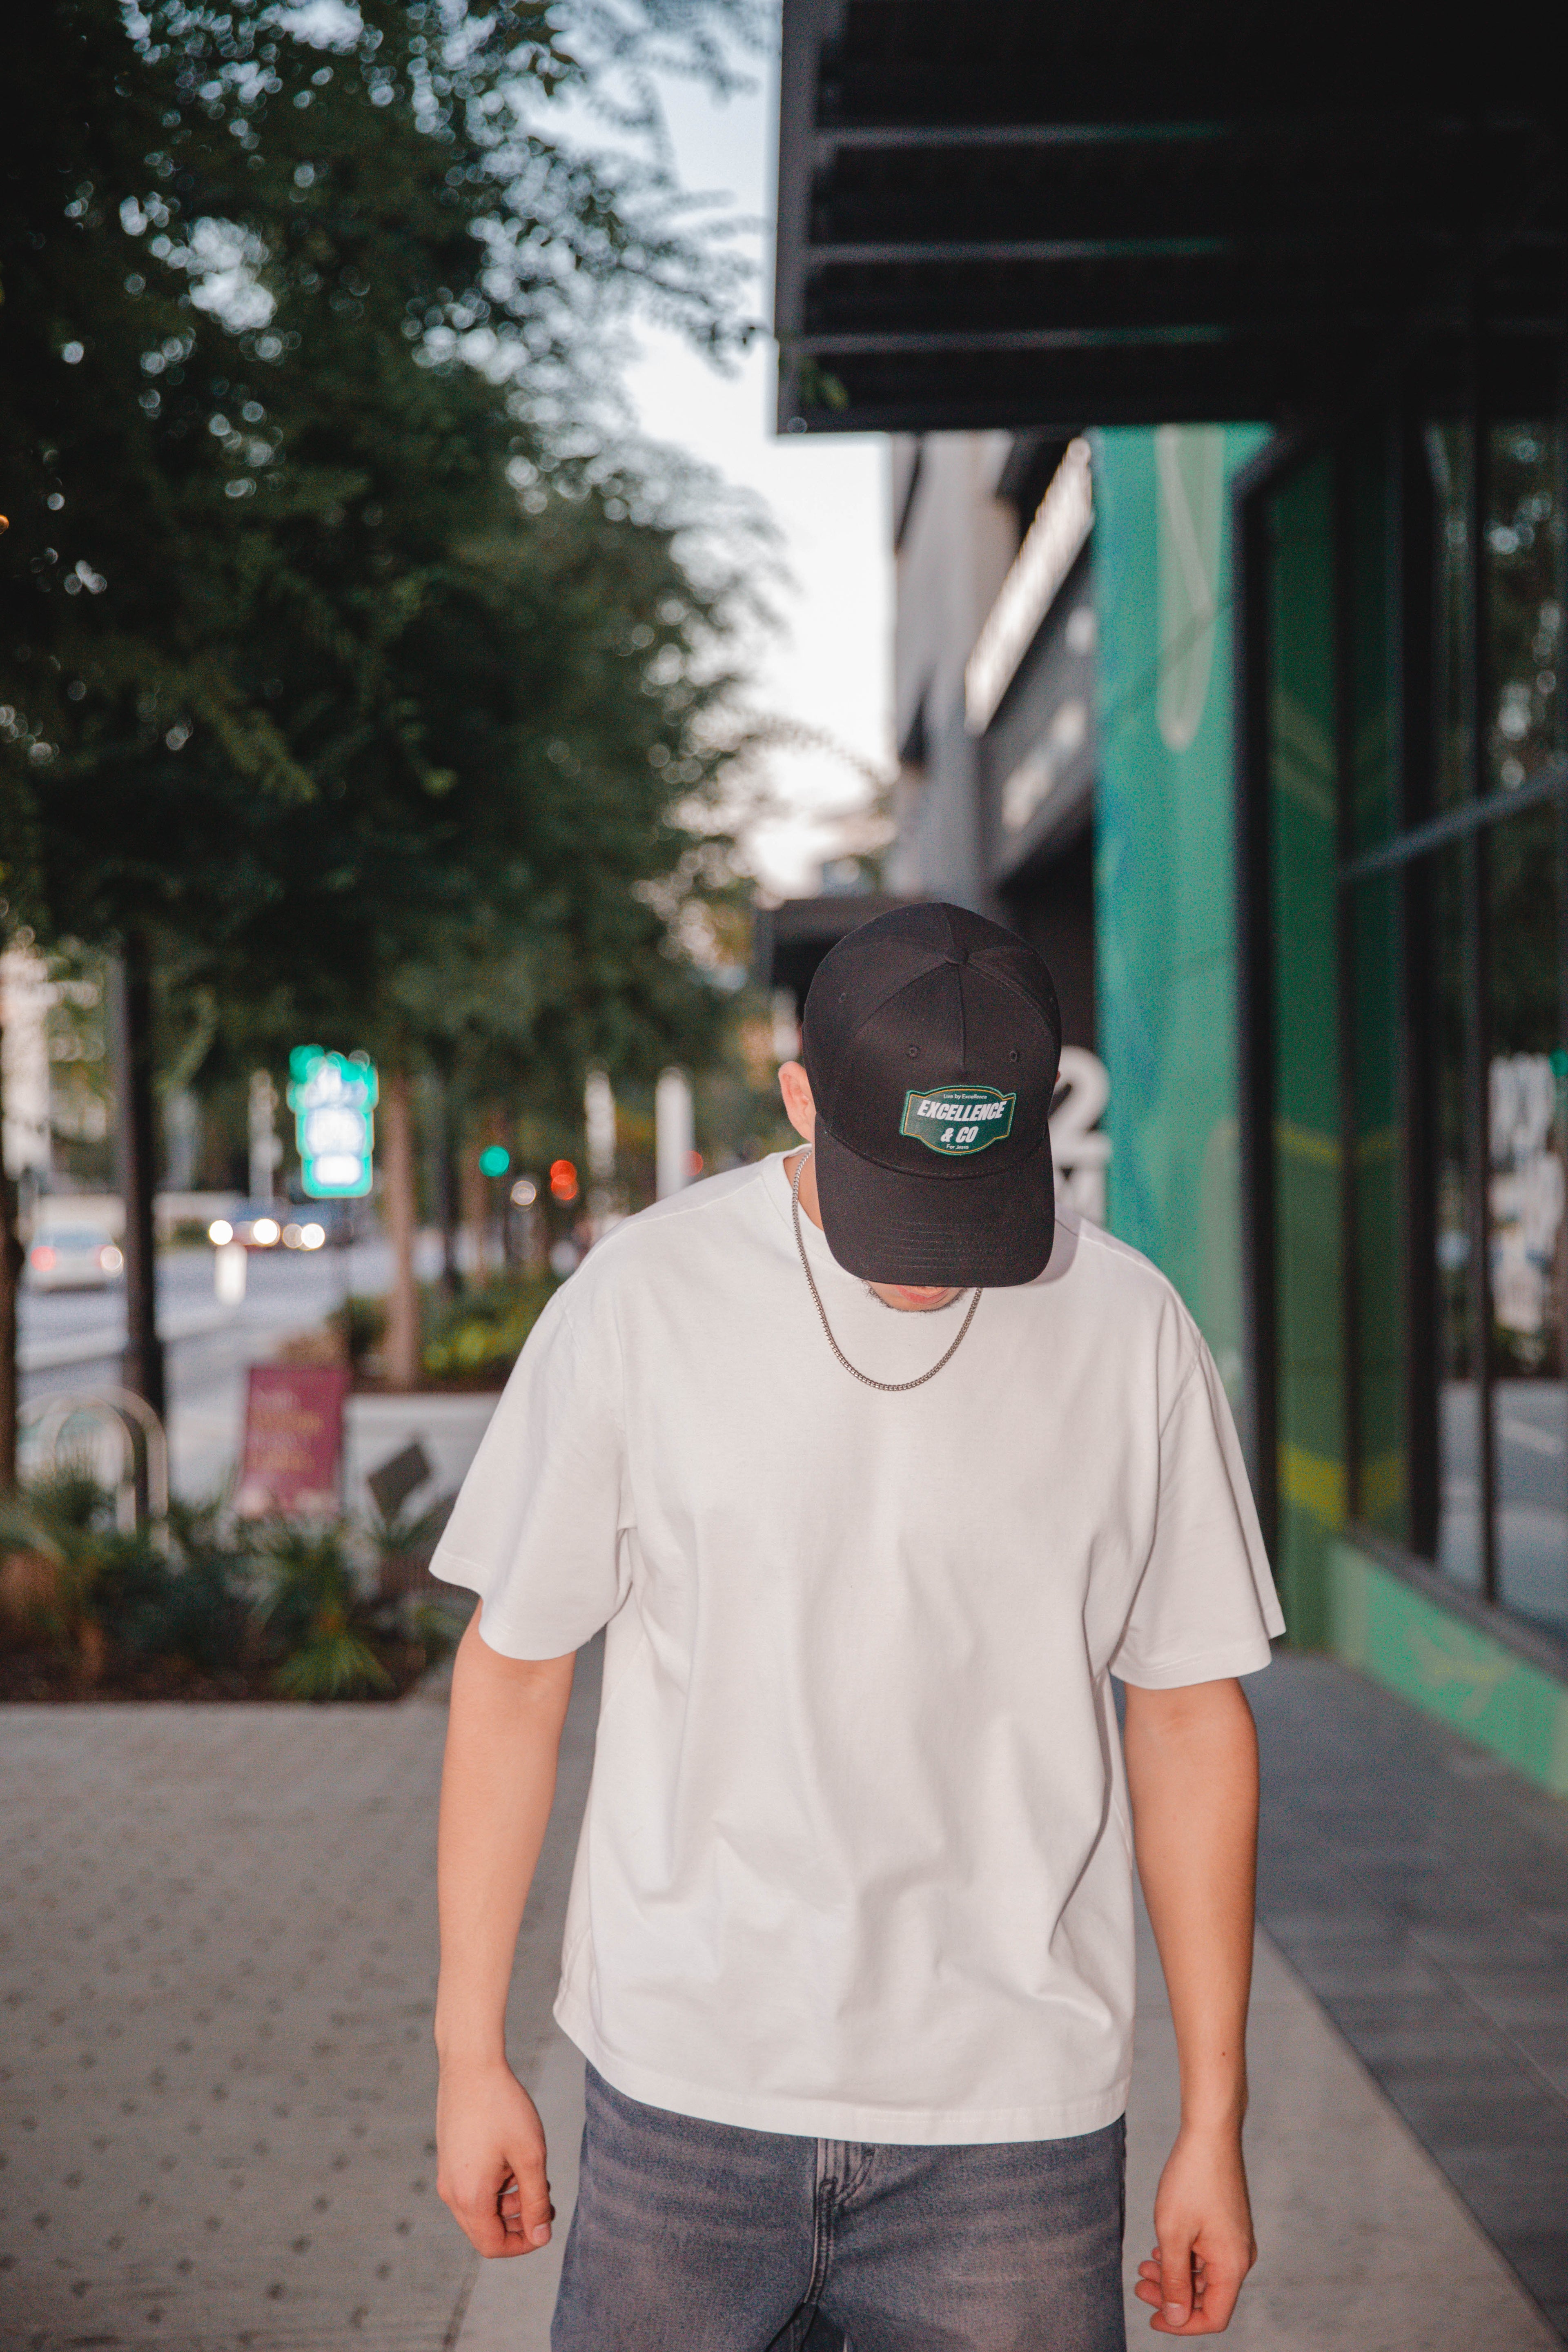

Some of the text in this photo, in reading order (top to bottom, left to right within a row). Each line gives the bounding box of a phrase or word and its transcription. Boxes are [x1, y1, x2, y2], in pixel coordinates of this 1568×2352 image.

[917, 1100, 1007, 1121] EXCELLENCE
[940, 1126, 979, 1143] & CO
